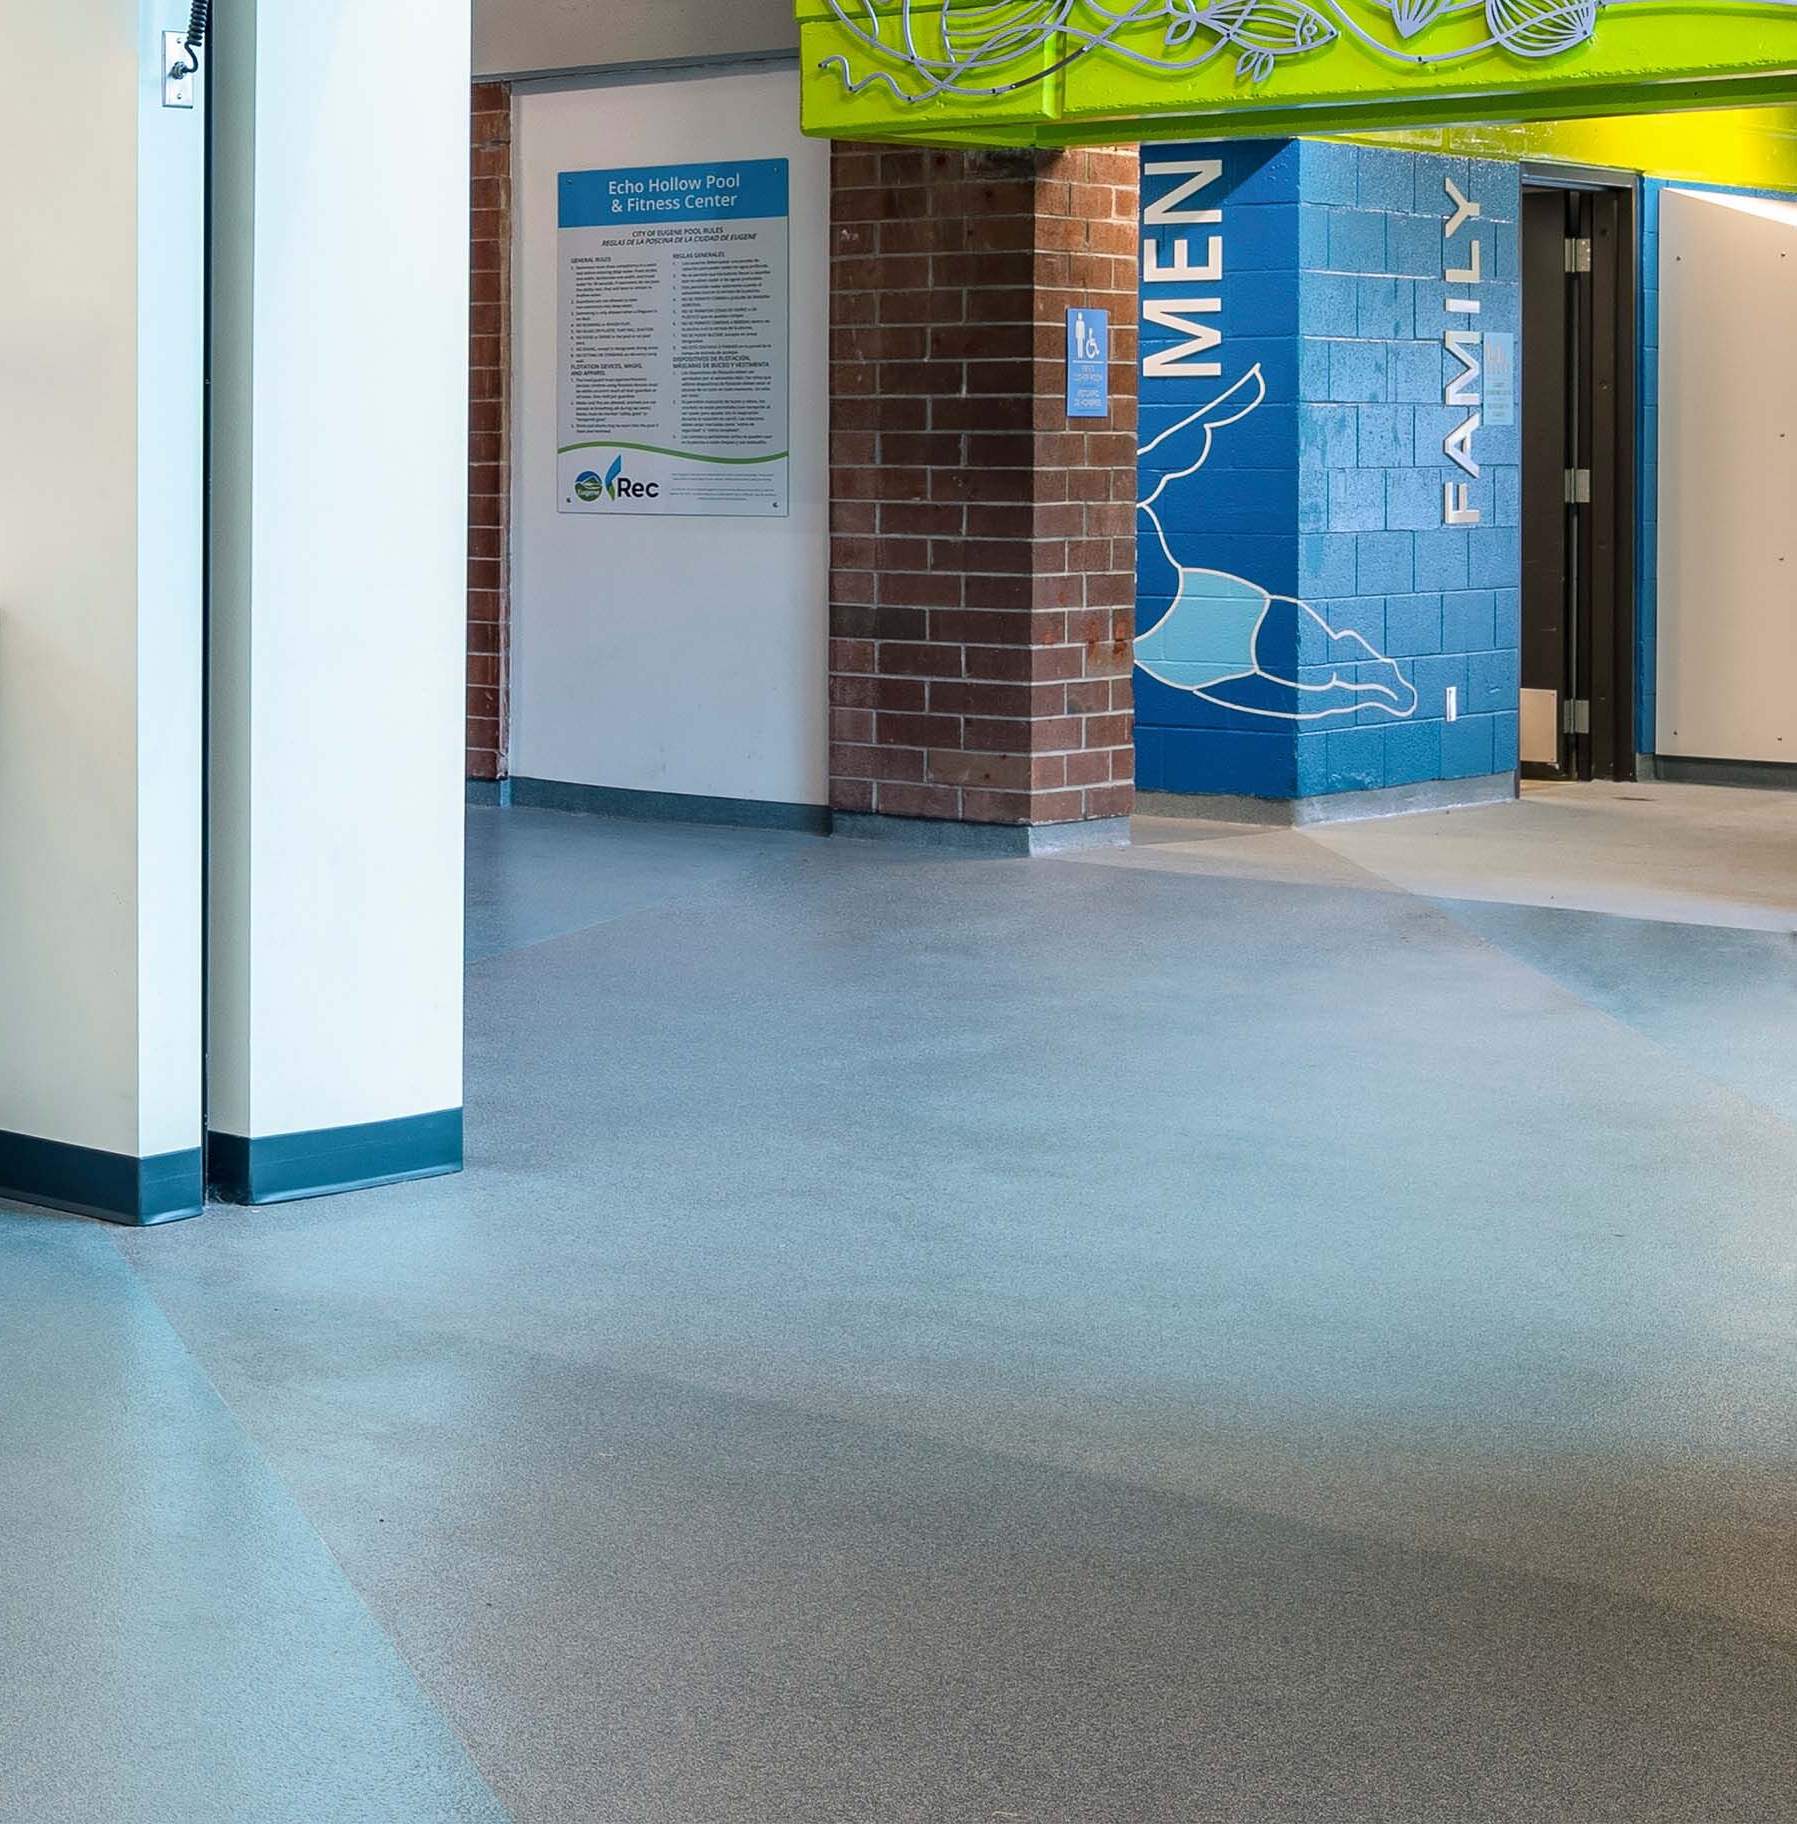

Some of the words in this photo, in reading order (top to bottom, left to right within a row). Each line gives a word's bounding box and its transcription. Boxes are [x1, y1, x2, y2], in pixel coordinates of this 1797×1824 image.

[608, 179, 644, 195] Echo
[648, 176, 702, 193] Hollow
[706, 173, 740, 189] Pool
[611, 198, 623, 213] &
[627, 196, 681, 212] Fitness
[684, 193, 738, 209] Center
[657, 228, 682, 236] EUGENE
[684, 227, 702, 235] POOL
[702, 226, 724, 235] RULES
[1144, 159, 1222, 378] MEN
[1444, 176, 1480, 527] FAMILY
[617, 477, 659, 498] Rec
